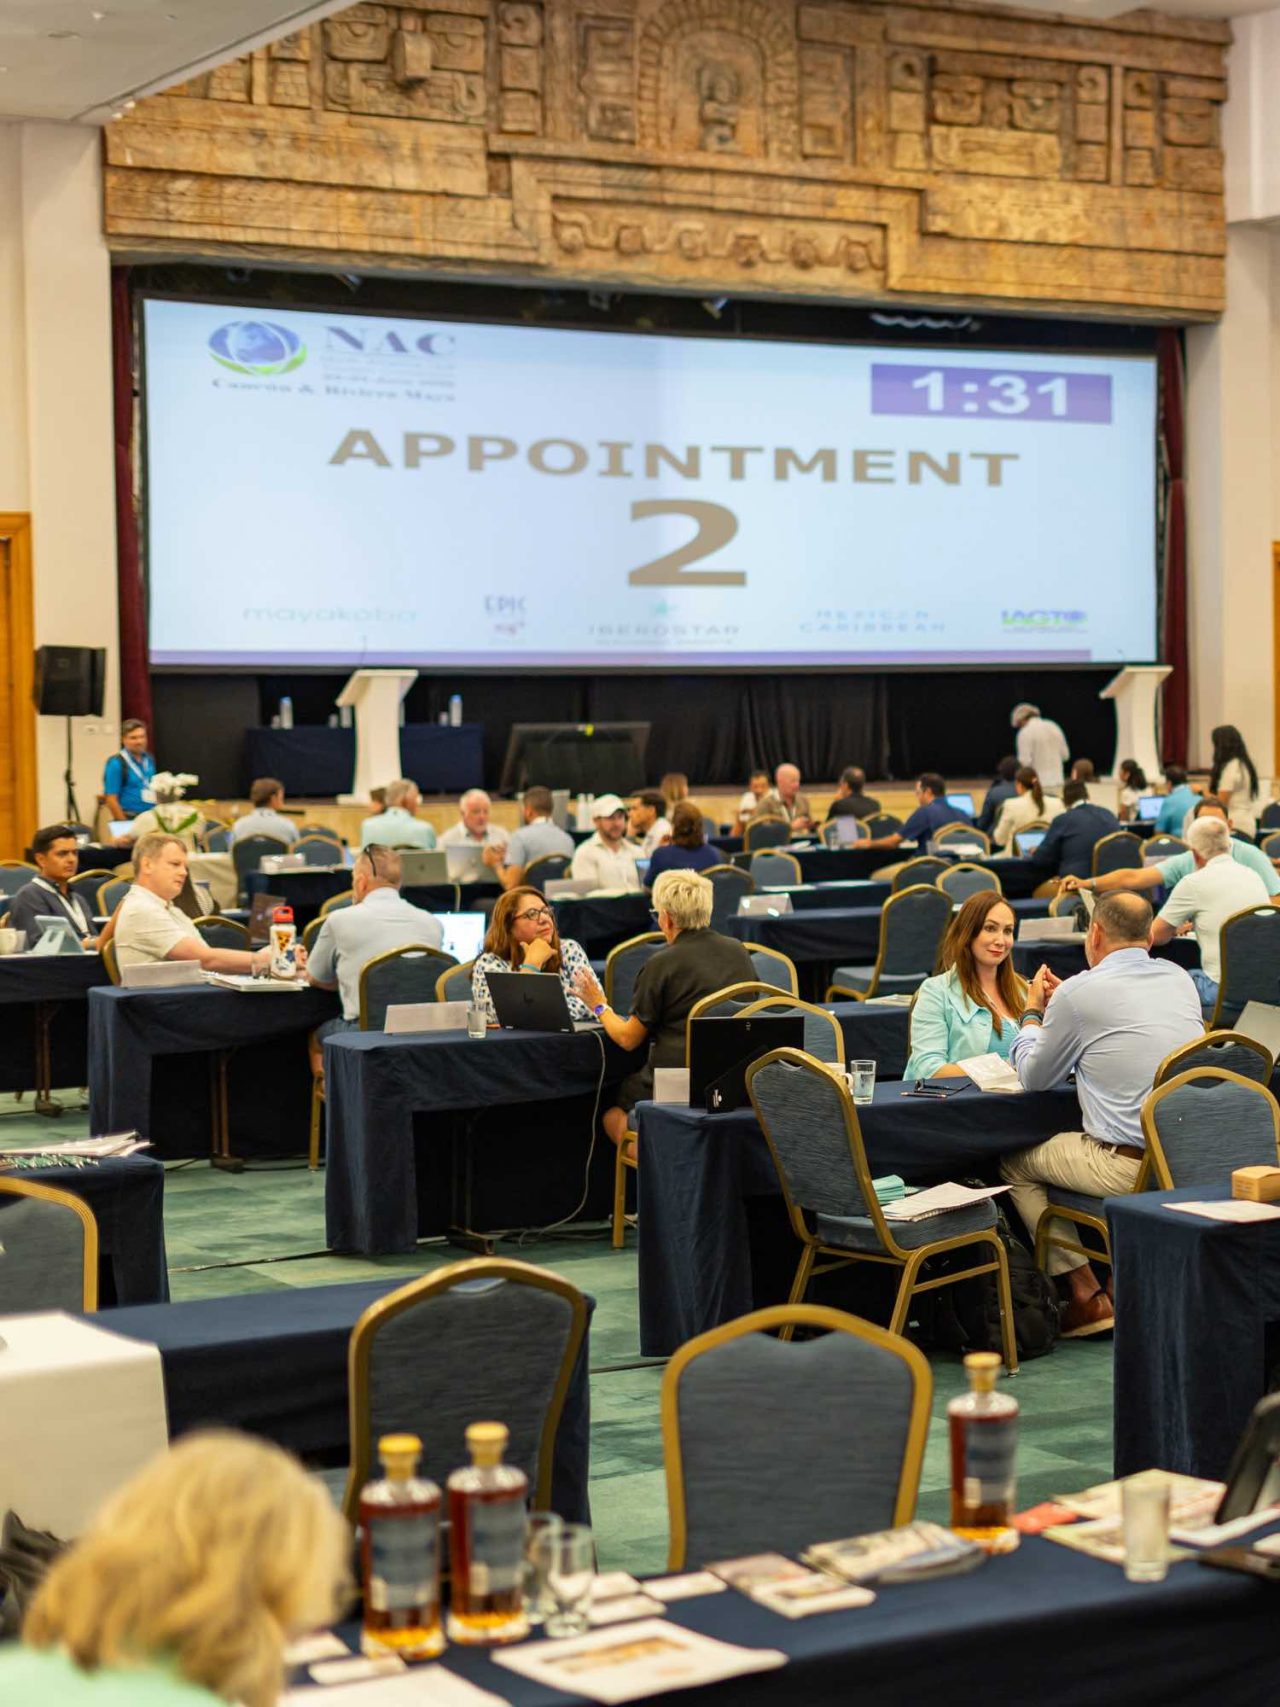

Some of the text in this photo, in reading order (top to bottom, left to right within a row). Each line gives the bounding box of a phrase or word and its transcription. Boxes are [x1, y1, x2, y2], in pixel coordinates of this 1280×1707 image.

[326, 326, 457, 355] NAC
[912, 371, 1068, 416] 1:31
[327, 428, 1020, 488] APPOINTMENT
[628, 499, 747, 587] 2
